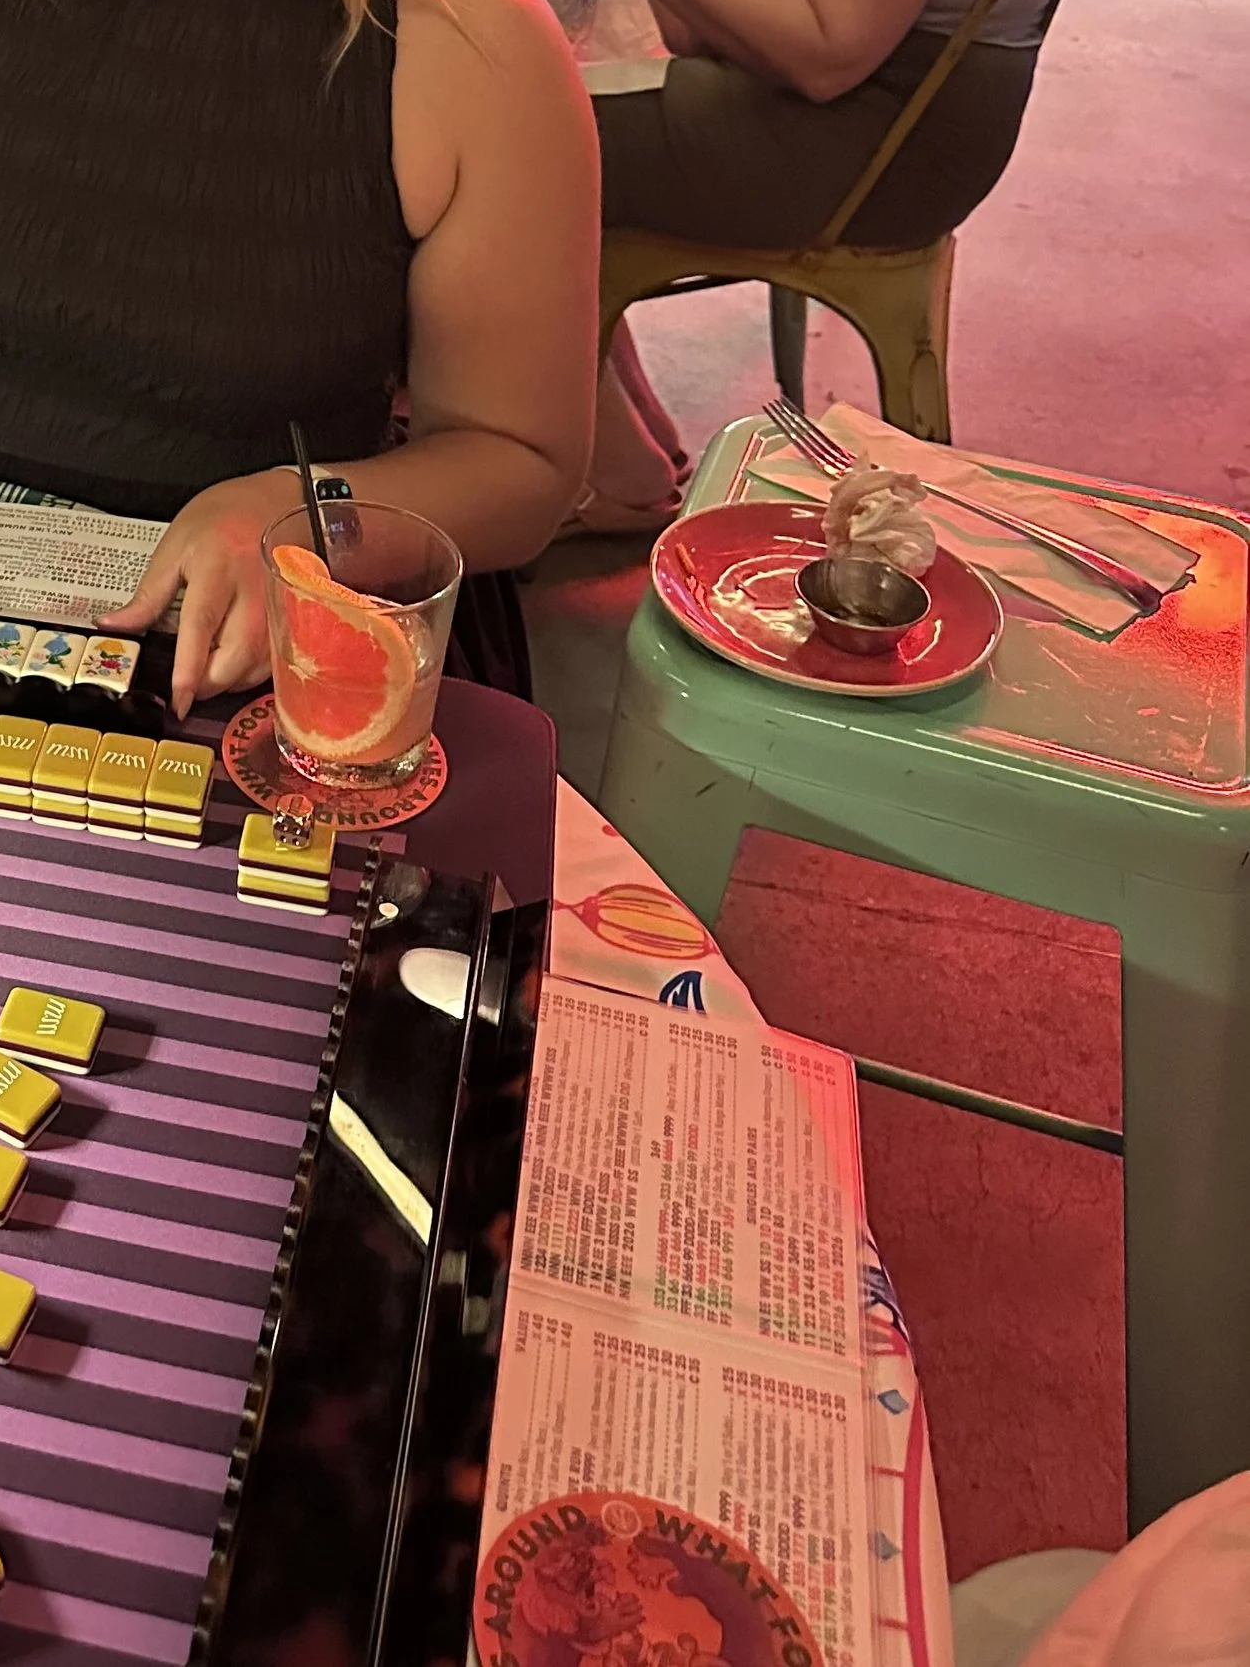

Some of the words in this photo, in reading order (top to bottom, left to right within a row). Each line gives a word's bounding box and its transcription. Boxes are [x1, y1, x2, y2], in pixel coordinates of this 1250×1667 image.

[315, 787, 429, 826] AROUND
[663, 1114, 674, 1138] 9999
[747, 1125, 757, 1155] PAIRS
[650, 1139, 660, 1158] 369
[627, 1167, 638, 1183] SS
[746, 1156, 757, 1179] AND
[597, 1195, 608, 1204] 4
[624, 1184, 637, 1218] WWW
[671, 1200, 682, 1228] 9999
[746, 1181, 756, 1225] SINGLES
[594, 1204, 607, 1237] WWW
[697, 1206, 708, 1238] NEWS
[593, 1237, 605, 1246] 3
[622, 1220, 635, 1252] 2026
[831, 1235, 843, 1267] 2026
[534, 1246, 547, 1275] 1234
[590, 1270, 602, 1281] N
[591, 1261, 603, 1271] 2
[514, 1309, 529, 1354] VALUES
[654, 1507, 780, 1603] WHAT
[483, 1503, 588, 1641] AROUND
